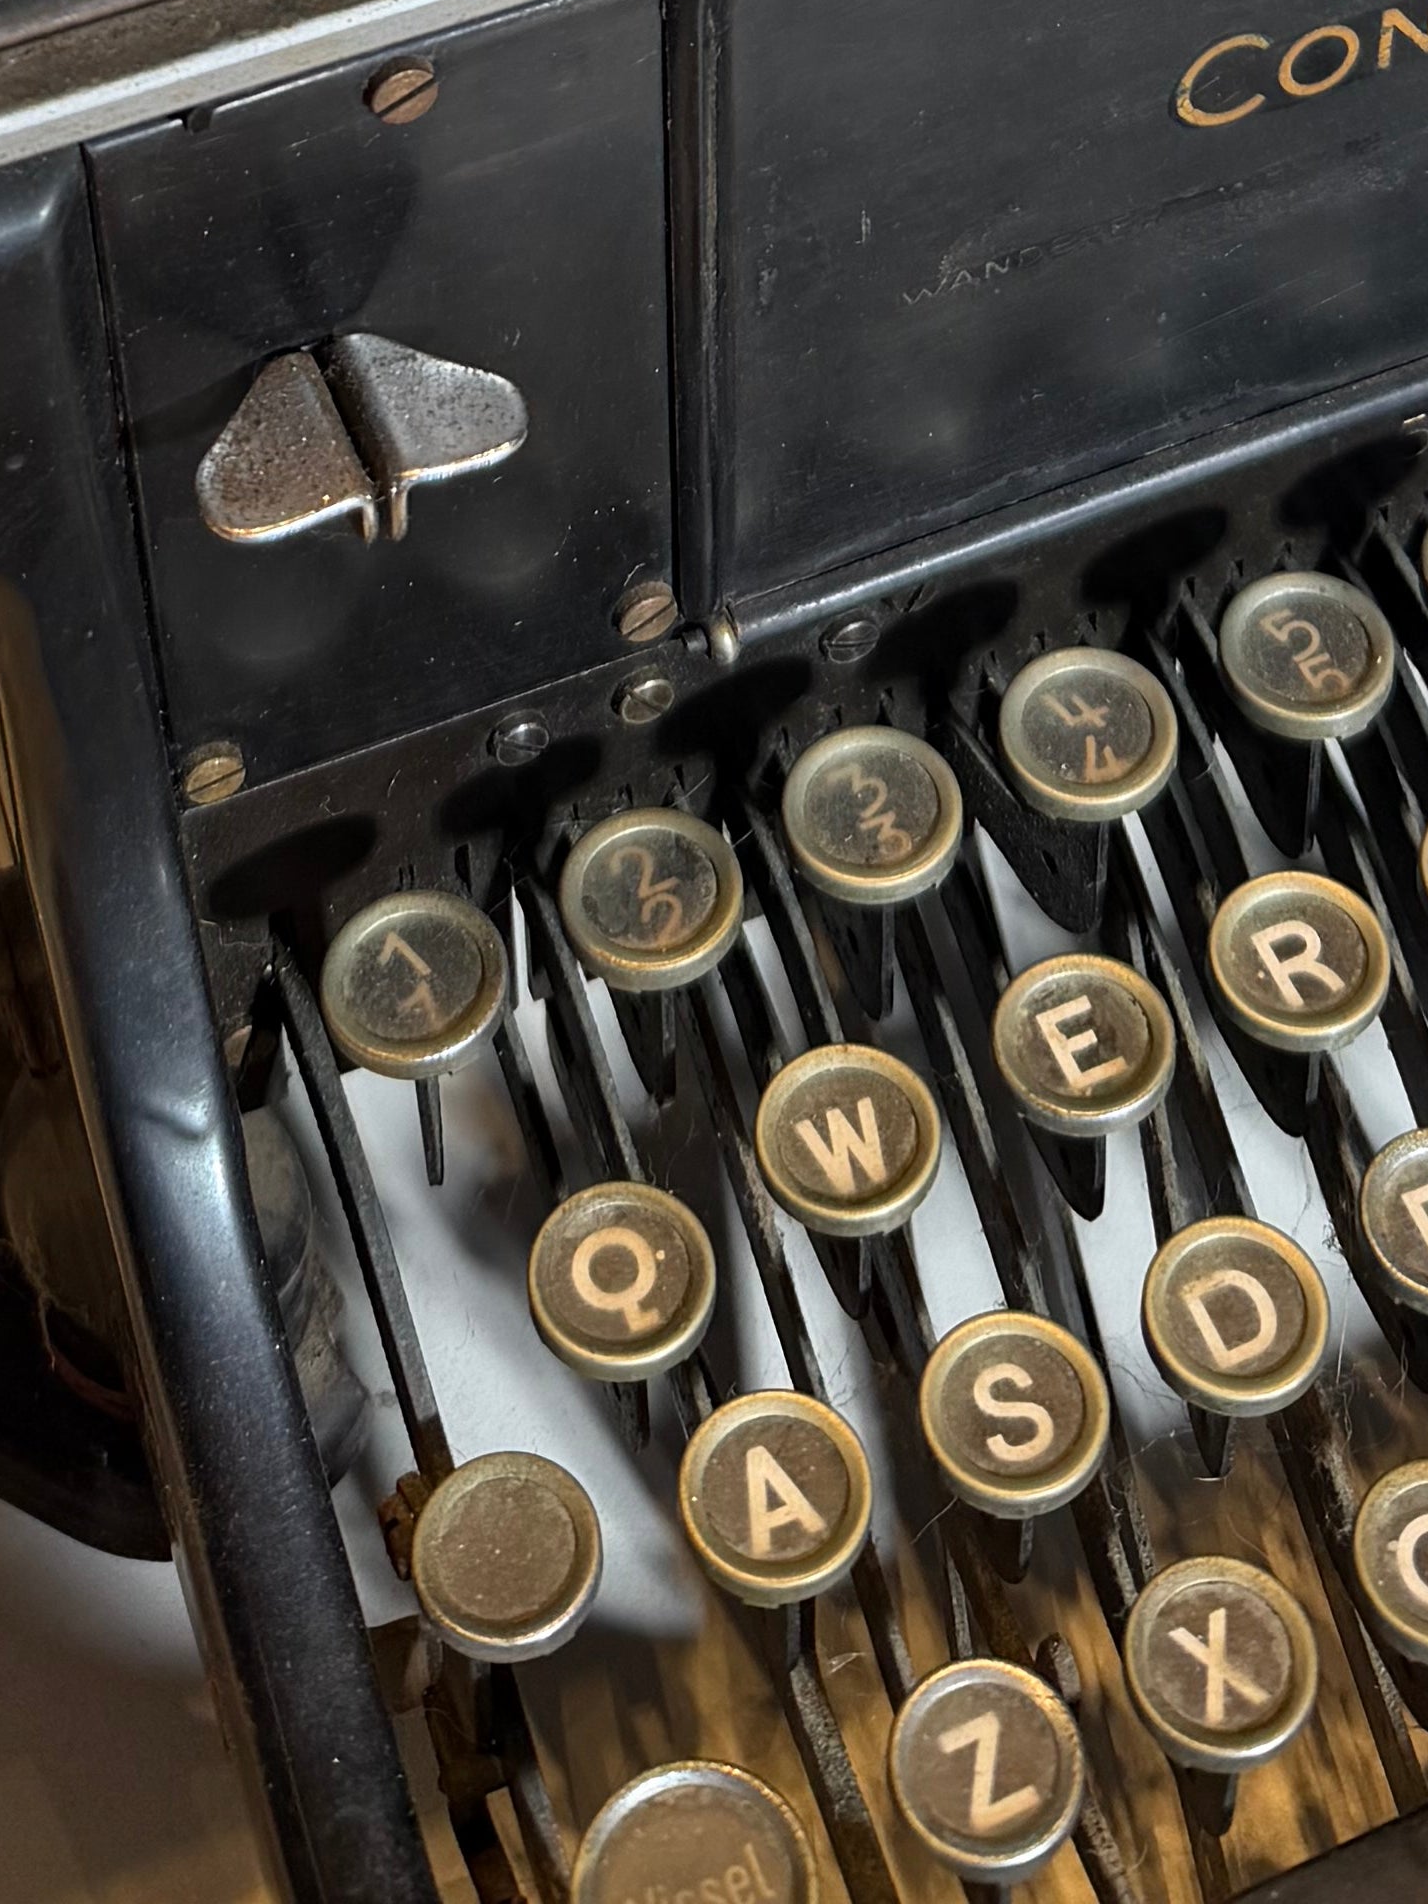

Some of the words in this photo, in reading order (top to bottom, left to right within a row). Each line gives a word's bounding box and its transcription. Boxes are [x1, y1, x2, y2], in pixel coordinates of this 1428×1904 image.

[1250, 919, 1346, 1007] R
[1035, 994, 1128, 1095] E
[793, 1095, 887, 1193] W
[571, 1224, 662, 1334] Q
[1183, 1268, 1278, 1371] D
[972, 1361, 1055, 1463] S
[744, 1443, 829, 1560] A
[1167, 1606, 1272, 1728] X
[936, 1710, 1041, 1835] Z
